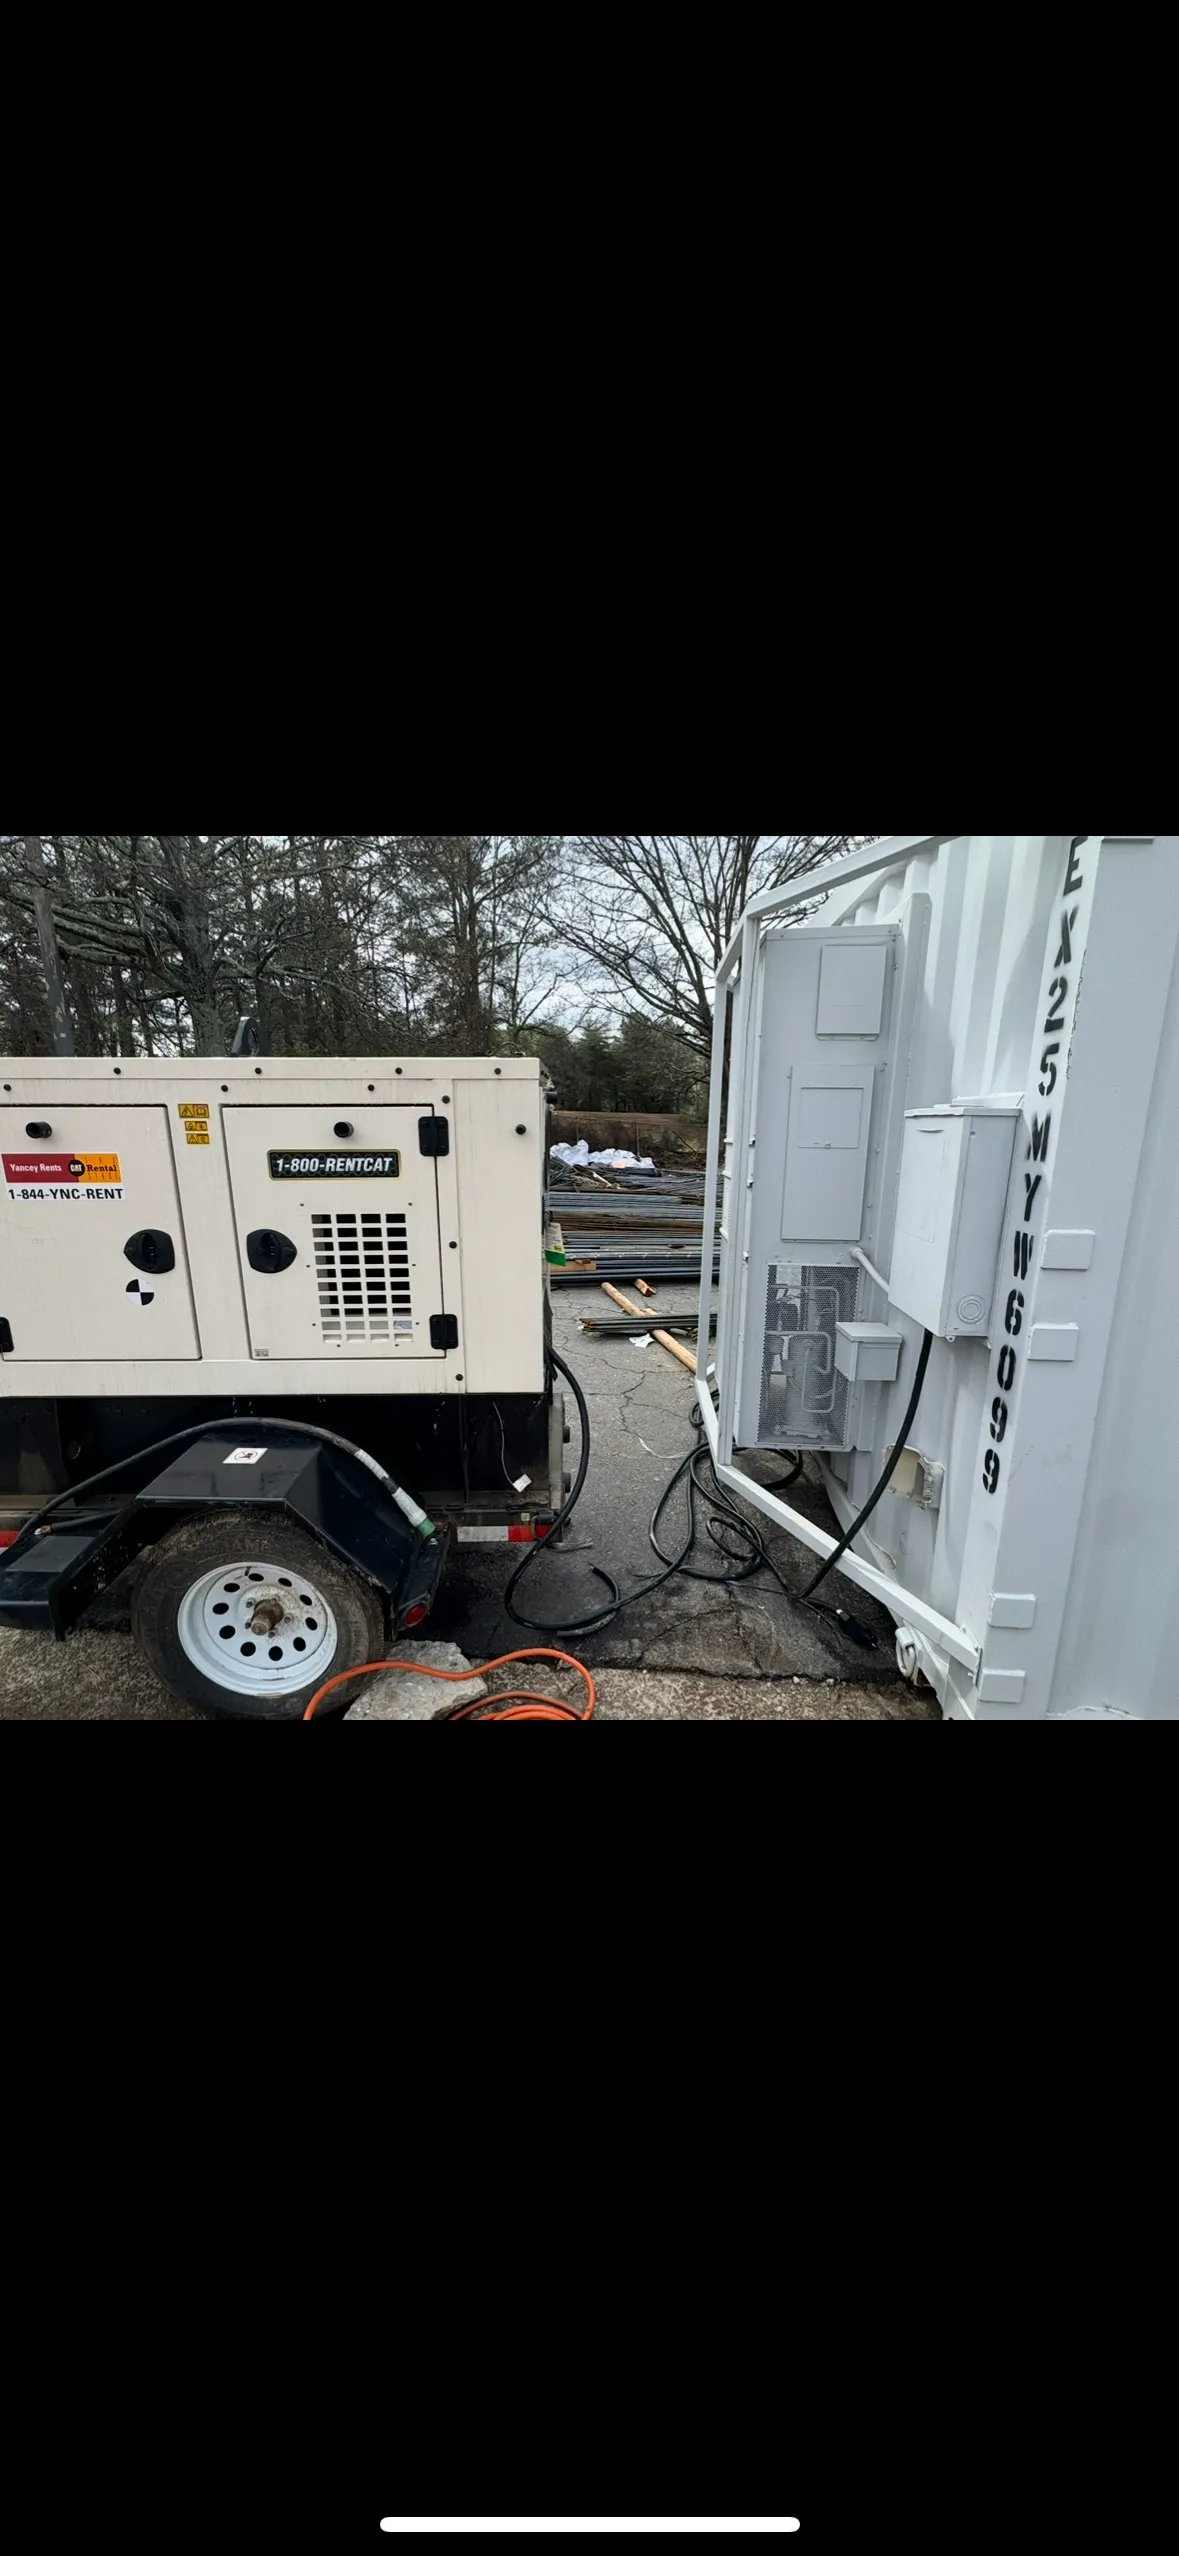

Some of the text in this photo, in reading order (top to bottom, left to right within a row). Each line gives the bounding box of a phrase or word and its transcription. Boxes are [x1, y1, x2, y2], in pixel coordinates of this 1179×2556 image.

[10, 1163, 117, 1173] Yancey Rents CAT Rental
[276, 1158, 393, 1172] 1-800-RENTCAT
[8, 1188, 123, 1200] 1-844-YNC-RENT
